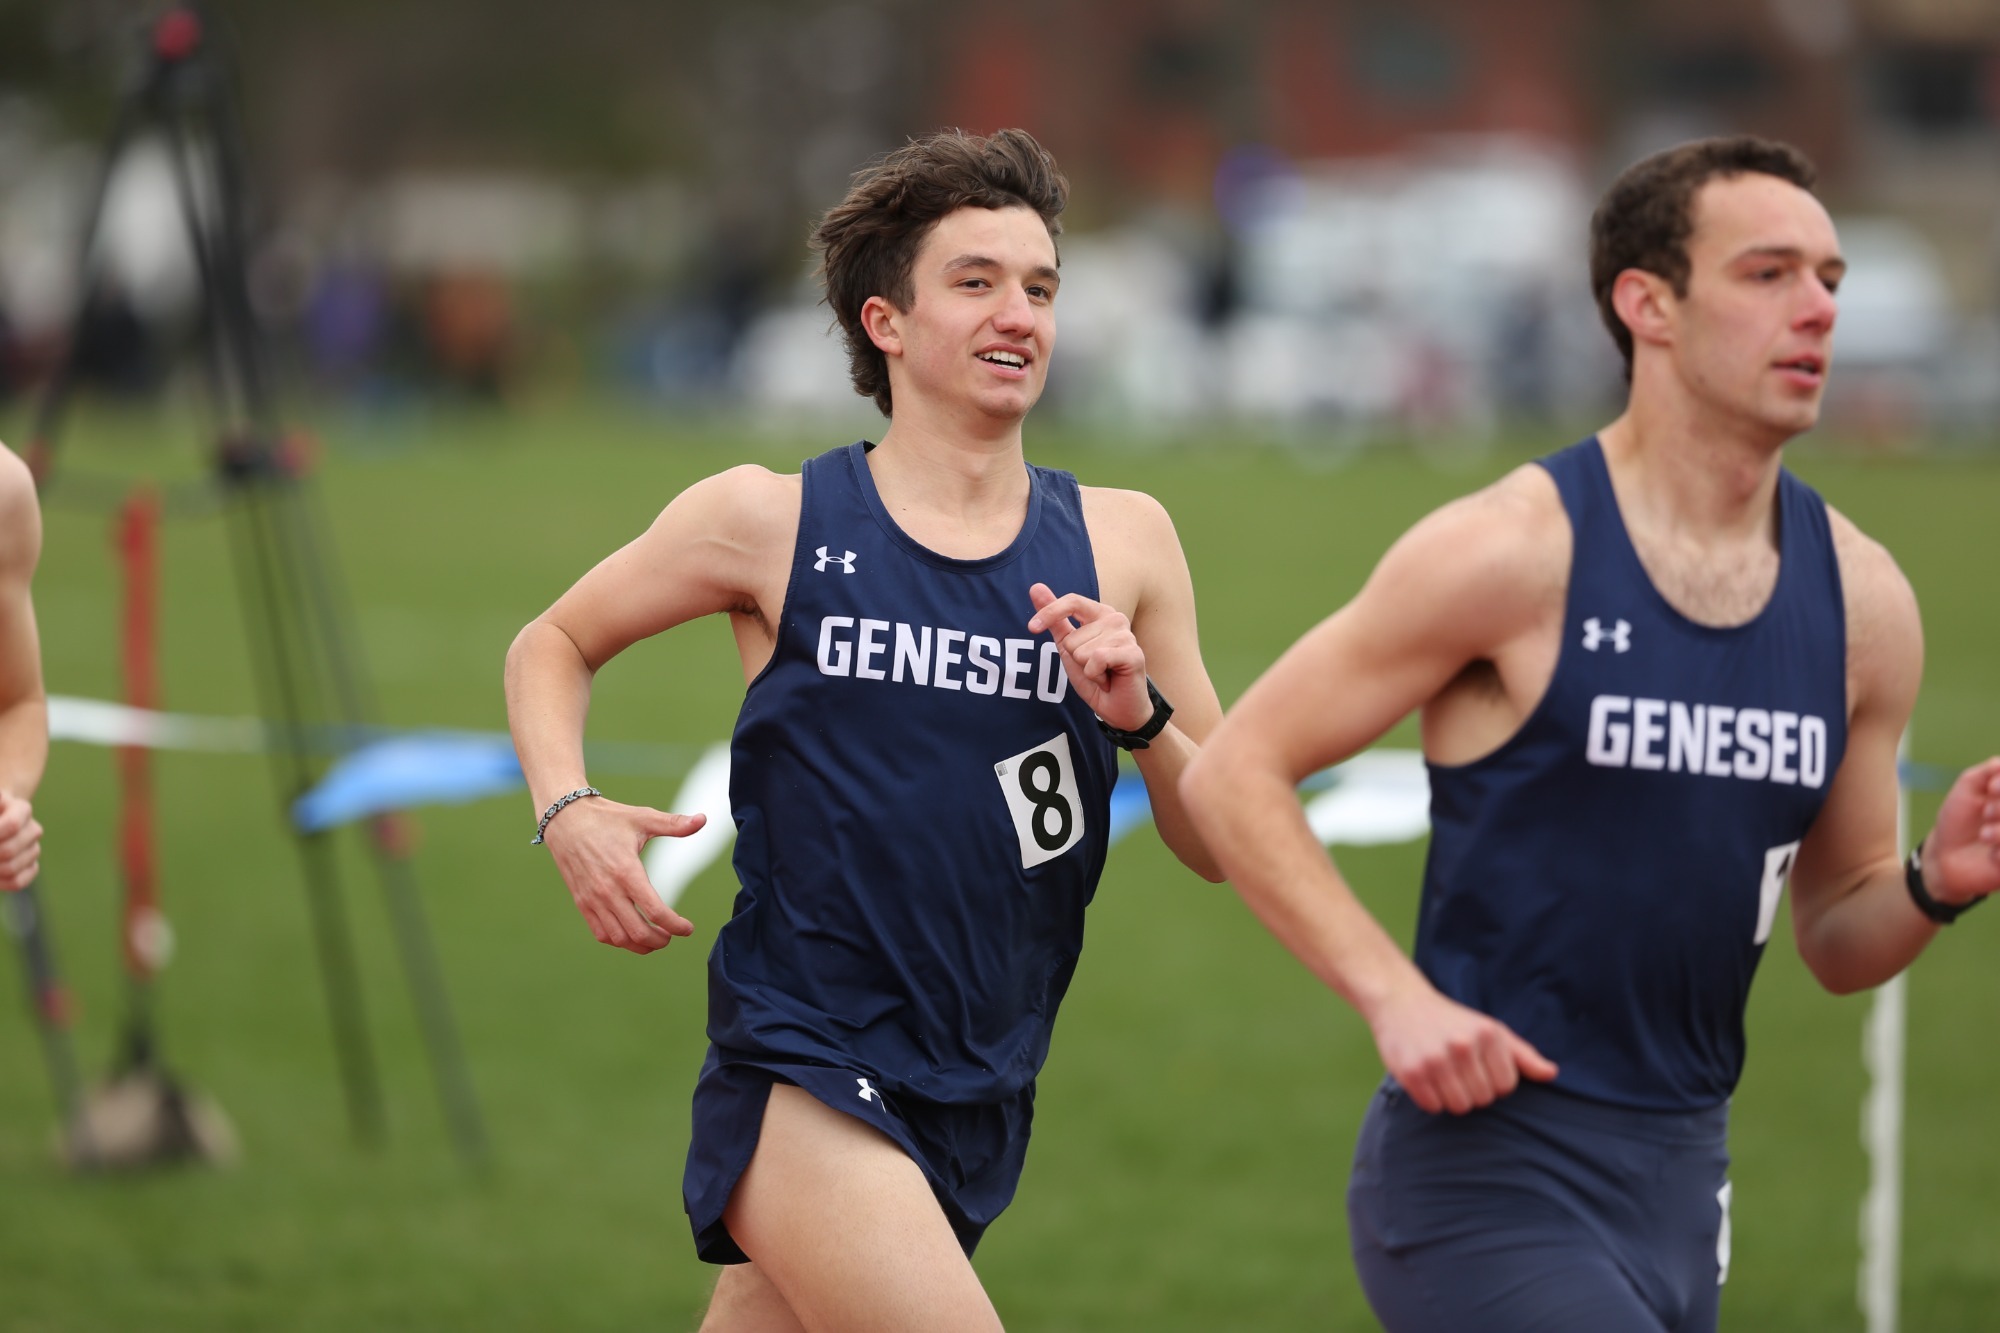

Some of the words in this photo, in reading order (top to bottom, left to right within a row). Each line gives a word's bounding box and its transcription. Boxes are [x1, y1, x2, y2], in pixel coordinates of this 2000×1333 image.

[817, 616, 1068, 704] GENESEO
[1585, 694, 1827, 789] GENESEO
[1018, 750, 1073, 851] 8
